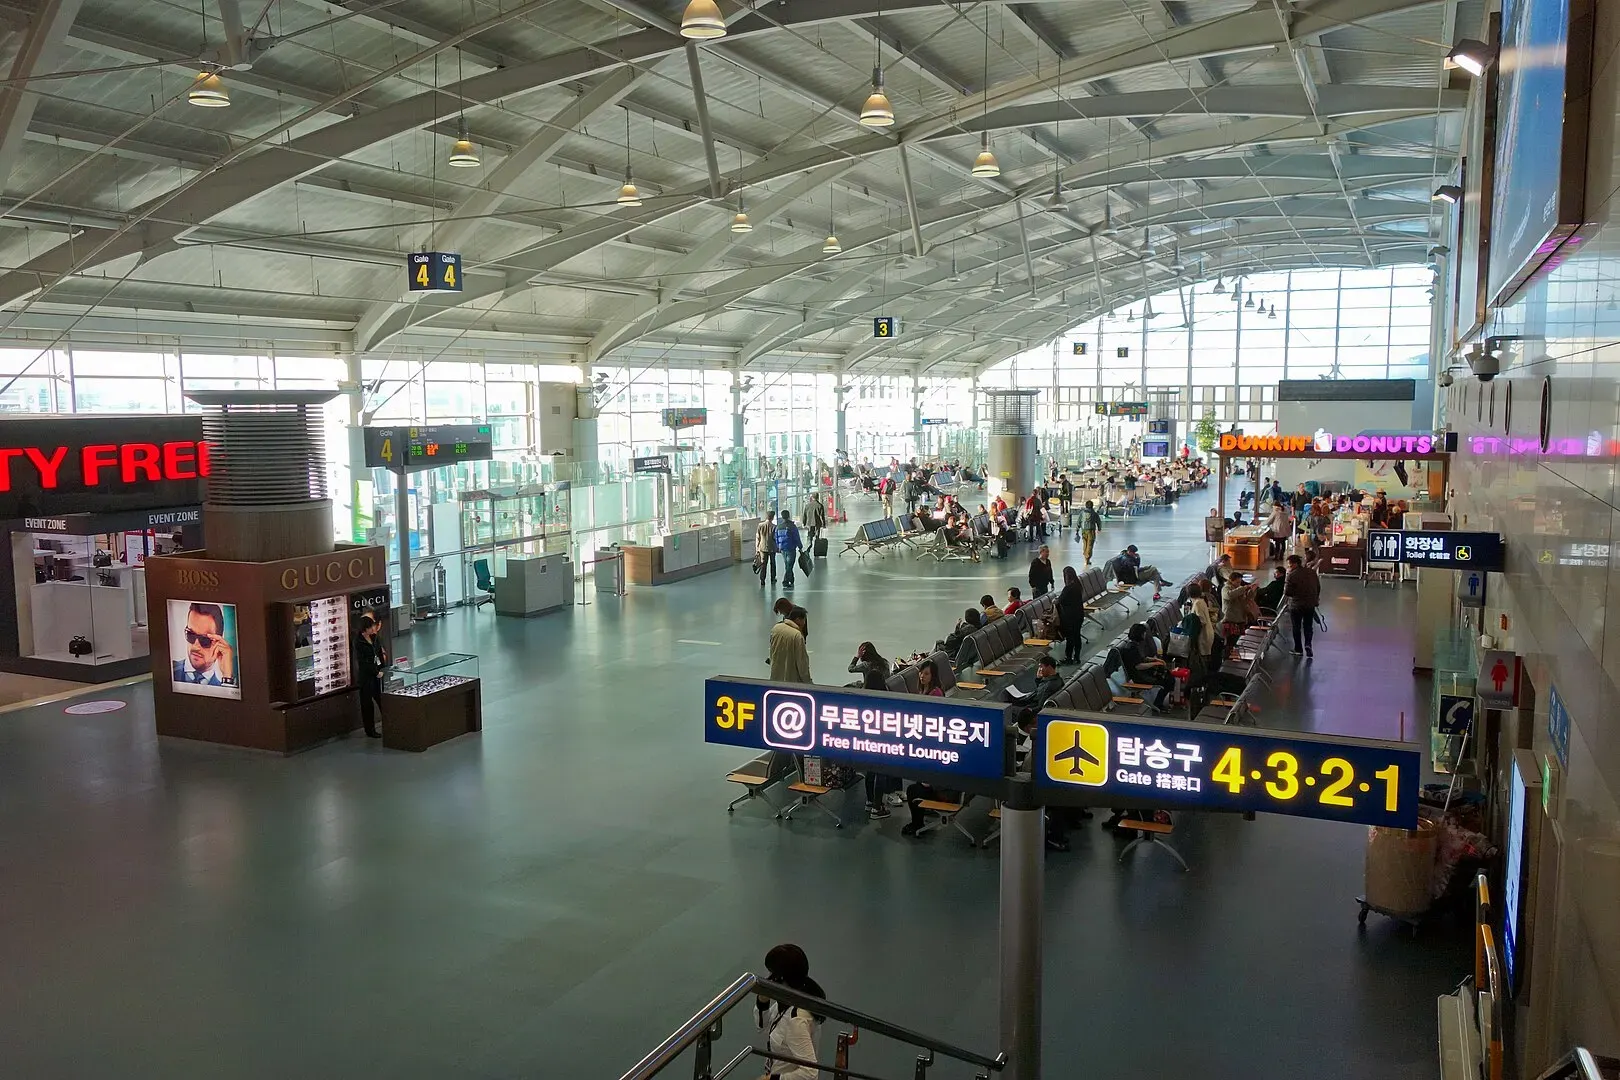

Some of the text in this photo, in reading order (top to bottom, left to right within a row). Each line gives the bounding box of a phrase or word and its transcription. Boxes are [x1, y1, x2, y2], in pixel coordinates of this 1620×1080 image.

[414, 255, 429, 263] Gate
[441, 254, 456, 264] Gate
[416, 264, 430, 287] 4
[444, 264, 456, 288] 4
[879, 323, 888, 336] 3
[1076, 346, 1083, 354] 2
[1097, 405, 1104, 414] 2
[668, 413, 674, 425] 3
[379, 429, 394, 437] Gate
[380, 438, 393, 463] 4
[1221, 434, 1431, 454] DUNKIN' DONUTS
[24, 517, 67, 530] EVENT ZONE
[148, 510, 199, 525] EVENT ZONE
[1405, 536, 1444, 551] 화장실
[1405, 551, 1425, 559] Toilet
[177, 569, 220, 587] BOSS
[281, 556, 374, 590] GUCCI
[354, 595, 385, 609] GUCCI
[716, 695, 756, 731] 3F
[820, 704, 990, 748] 무료인터넷라운지
[822, 733, 960, 765] Free Internet Lounge
[1116, 736, 1203, 773] 탑승구
[1116, 769, 1152, 786] Gate
